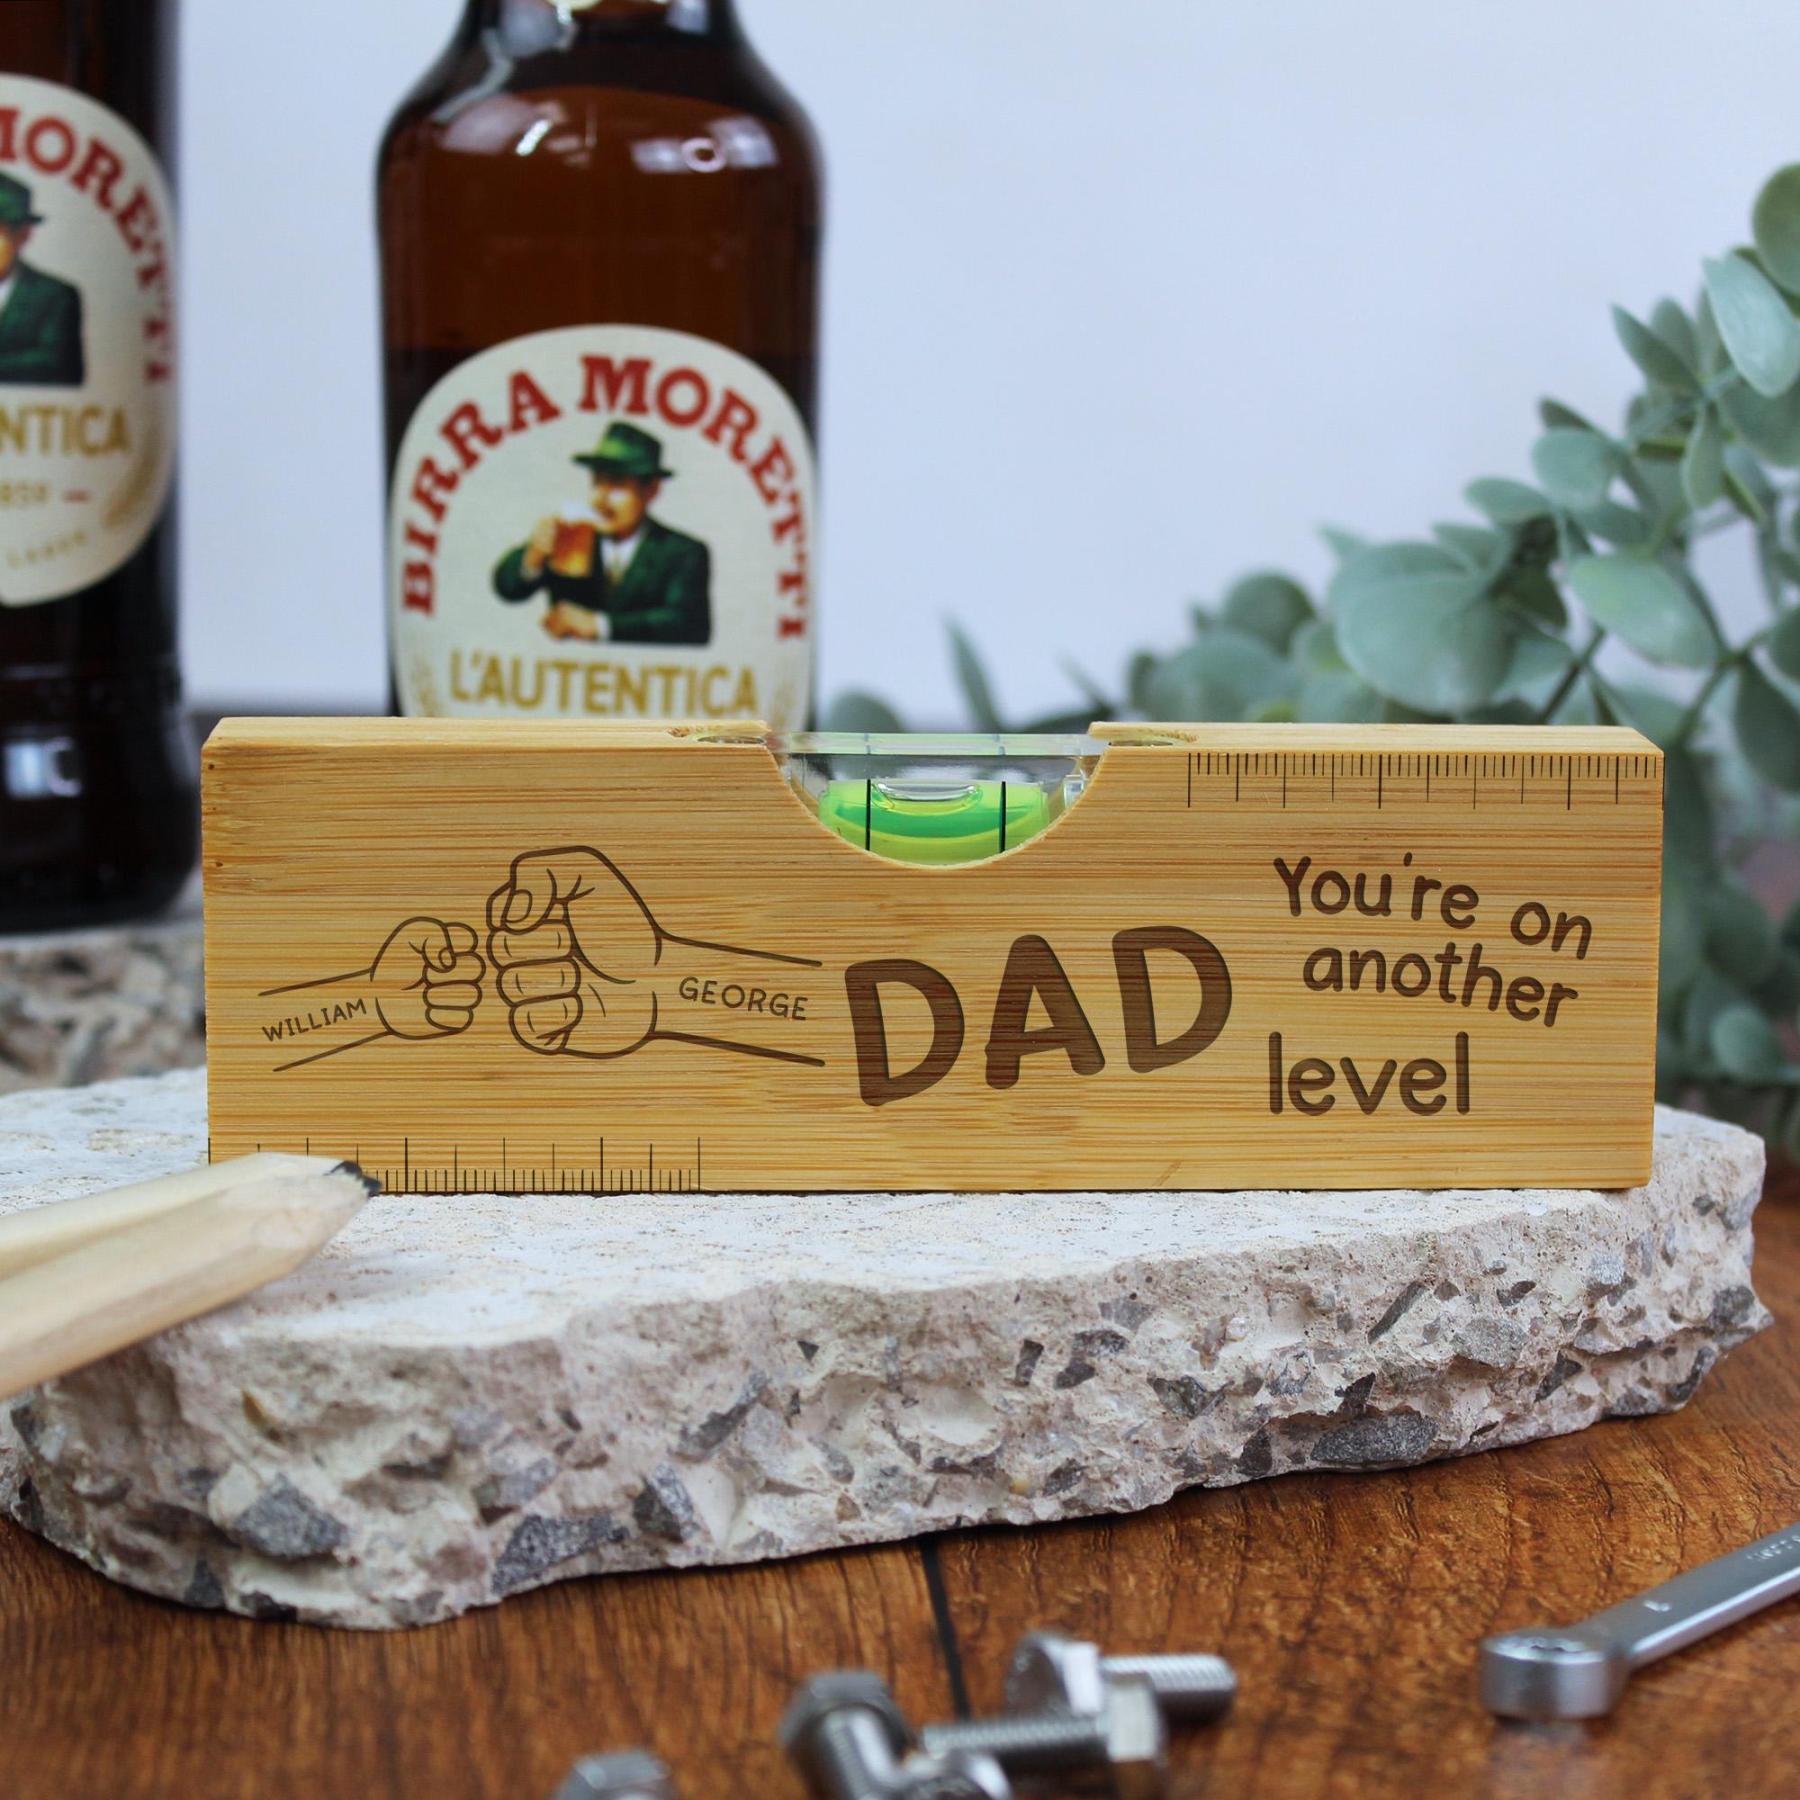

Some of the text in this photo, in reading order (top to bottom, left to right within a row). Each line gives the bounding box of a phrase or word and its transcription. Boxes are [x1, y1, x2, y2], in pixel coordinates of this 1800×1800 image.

[0, 107, 171, 383] ORETTI
[402, 353, 808, 640] BIRRA MORETTI
[449, 649, 757, 716] L'AUTENTICA
[1274, 852, 1592, 960] You're on
[261, 998, 368, 1043] WILLIAM
[678, 975, 809, 1021] GEORGE
[845, 925, 1232, 1106] DAD
[1303, 941, 1578, 1027] another
[1268, 1031, 1471, 1114] level
